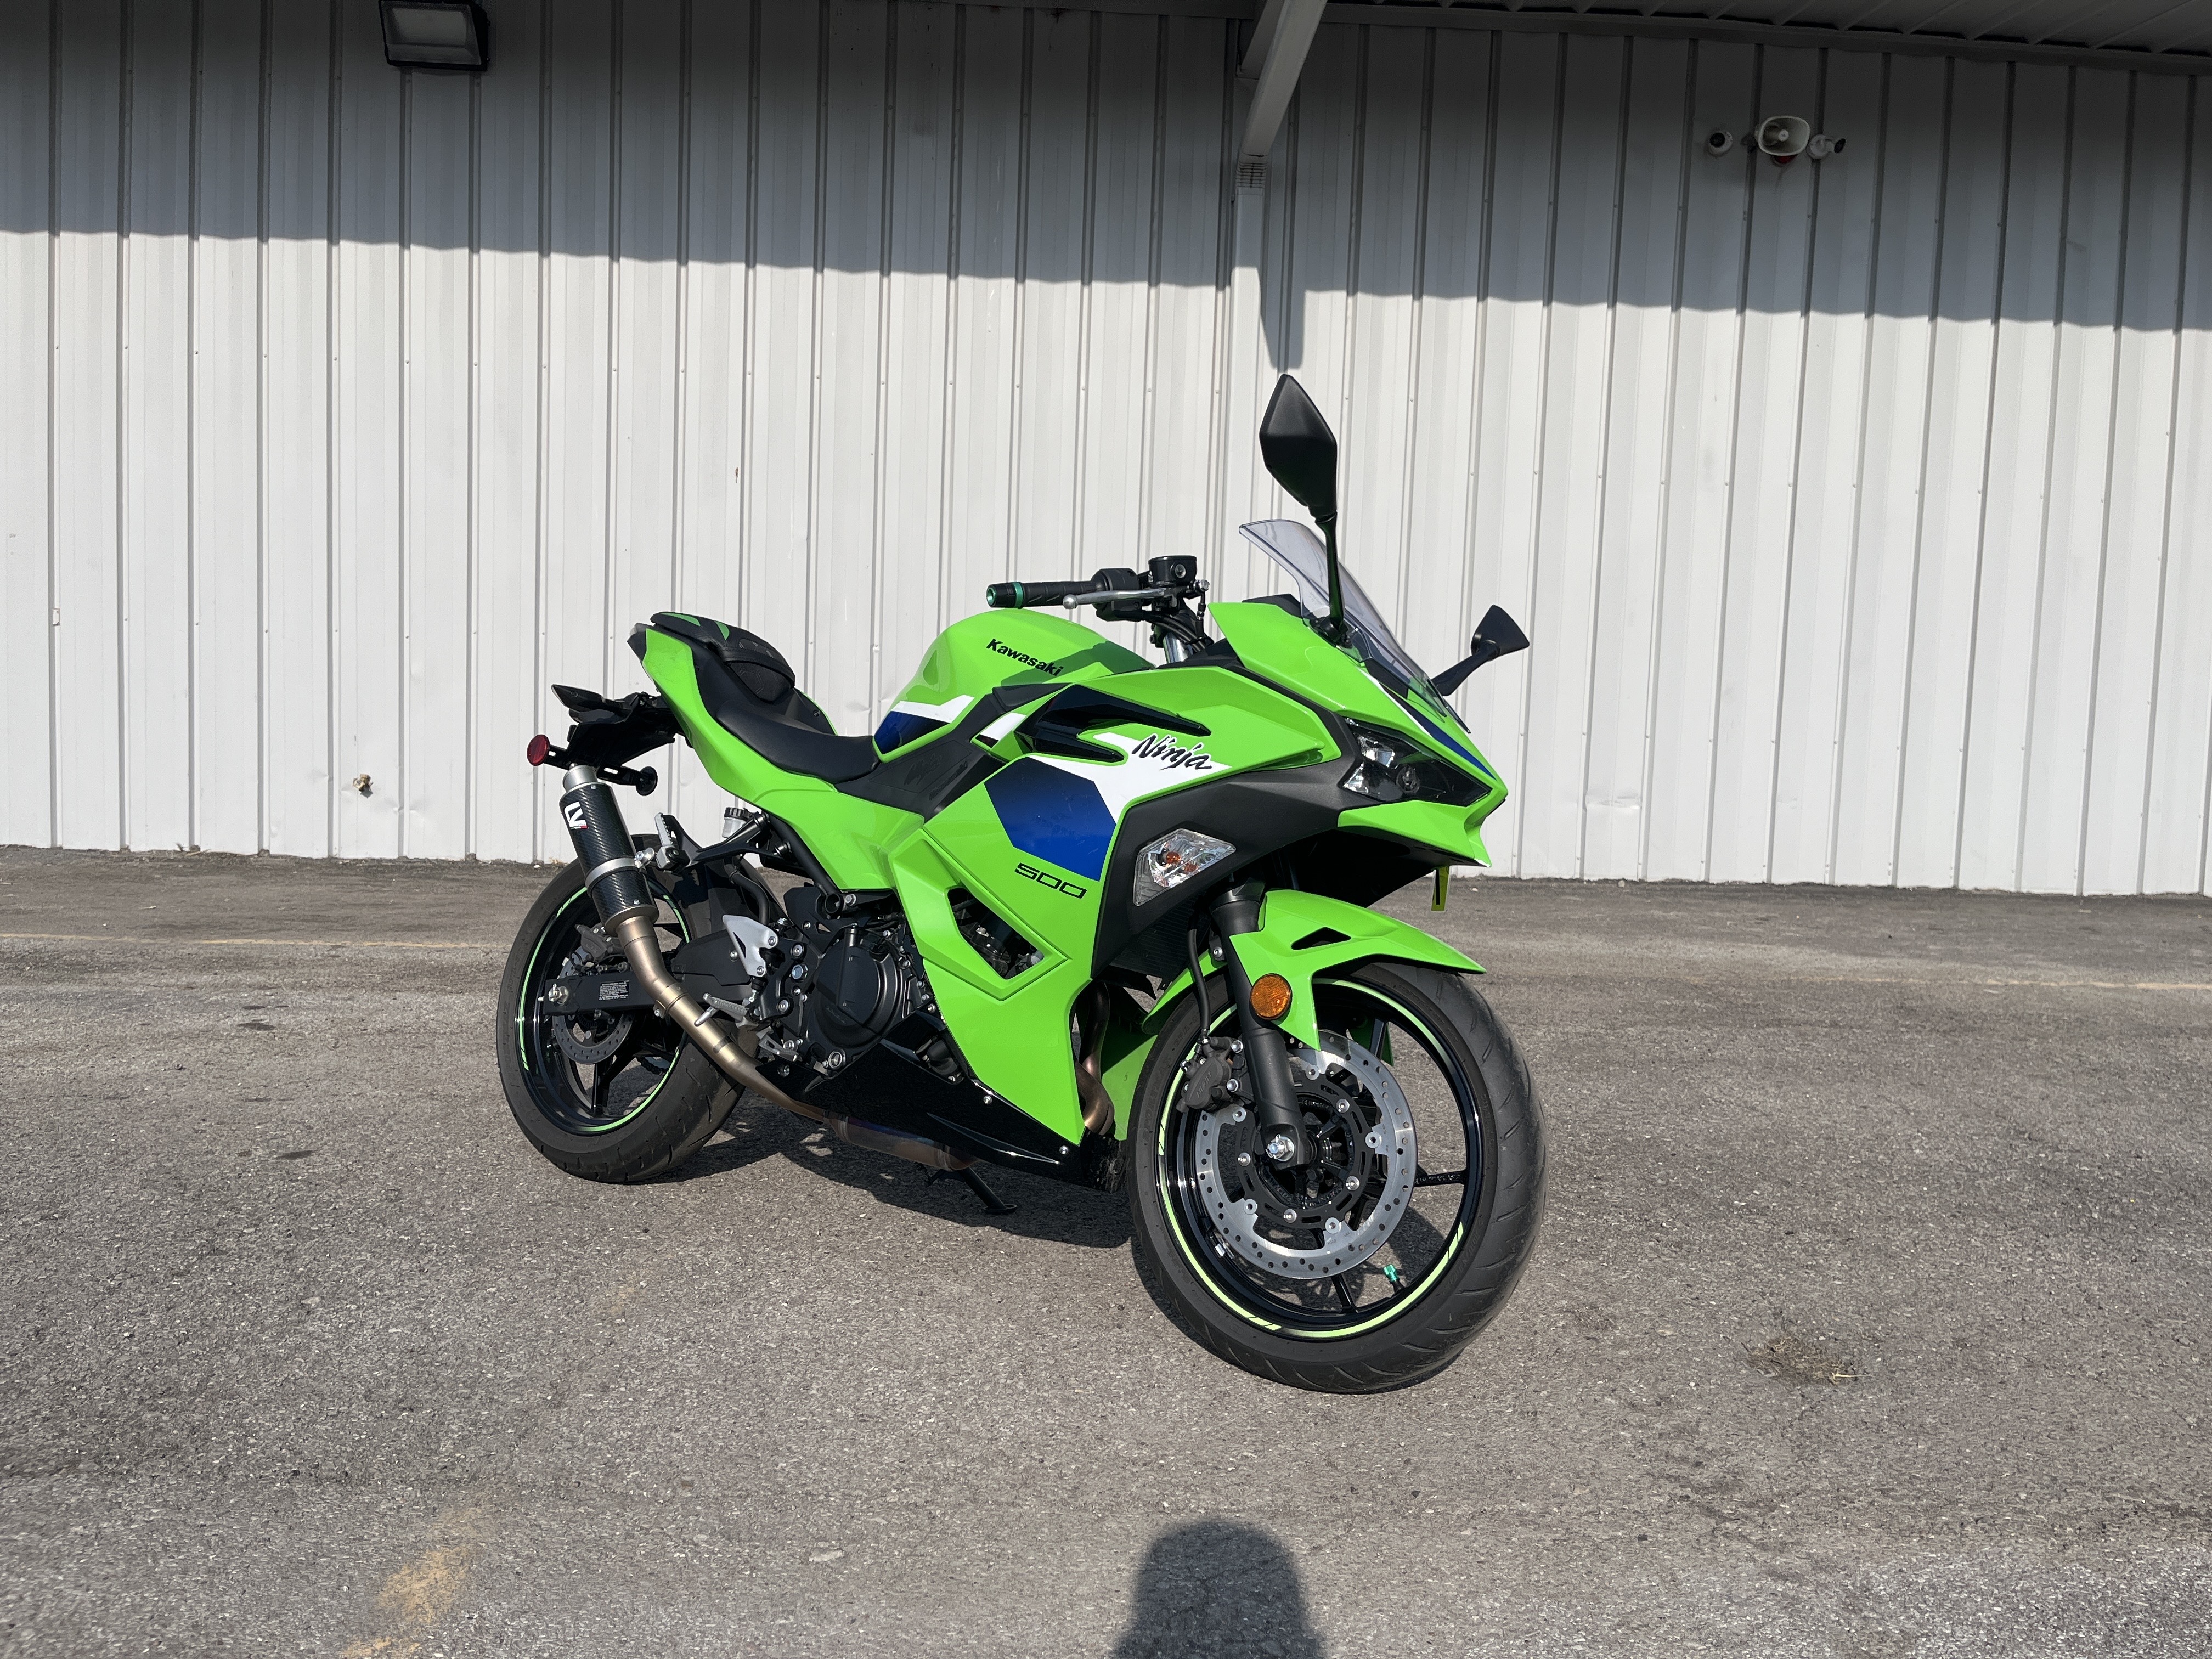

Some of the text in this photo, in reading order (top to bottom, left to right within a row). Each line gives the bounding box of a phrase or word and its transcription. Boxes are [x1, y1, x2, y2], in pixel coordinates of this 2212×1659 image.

[986, 638, 1064, 676] Kawasaki
[1131, 735, 1212, 771] Ninja
[1015, 862, 1087, 899] 500
